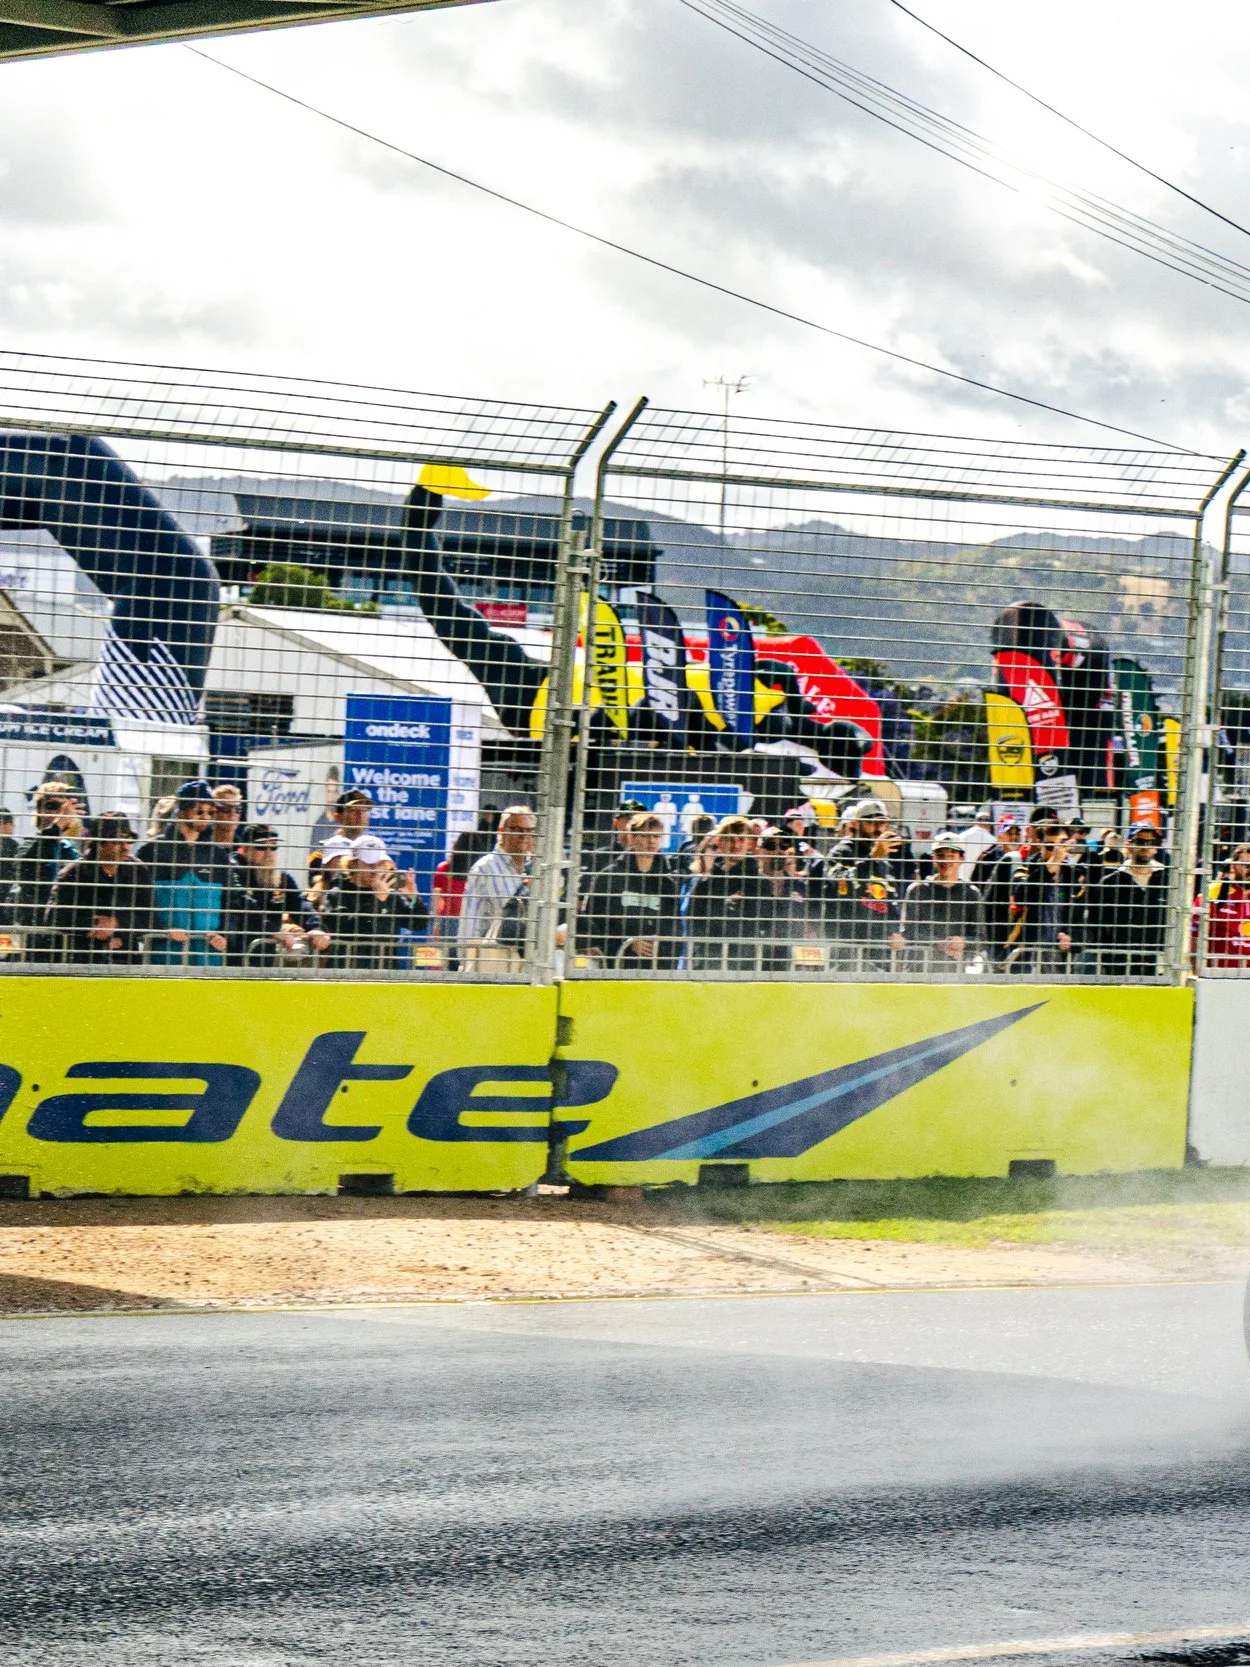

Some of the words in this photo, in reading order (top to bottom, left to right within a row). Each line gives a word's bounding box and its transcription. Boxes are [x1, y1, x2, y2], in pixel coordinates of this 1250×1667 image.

[644, 628, 680, 723] BJR
[52, 726, 109, 738] CREAM
[365, 724, 430, 739] ondeck
[352, 767, 441, 787] Welcome
[256, 768, 313, 816] Ford
[377, 786, 409, 803] the
[395, 804, 437, 821] lane
[0, 1031, 618, 1143] ate
